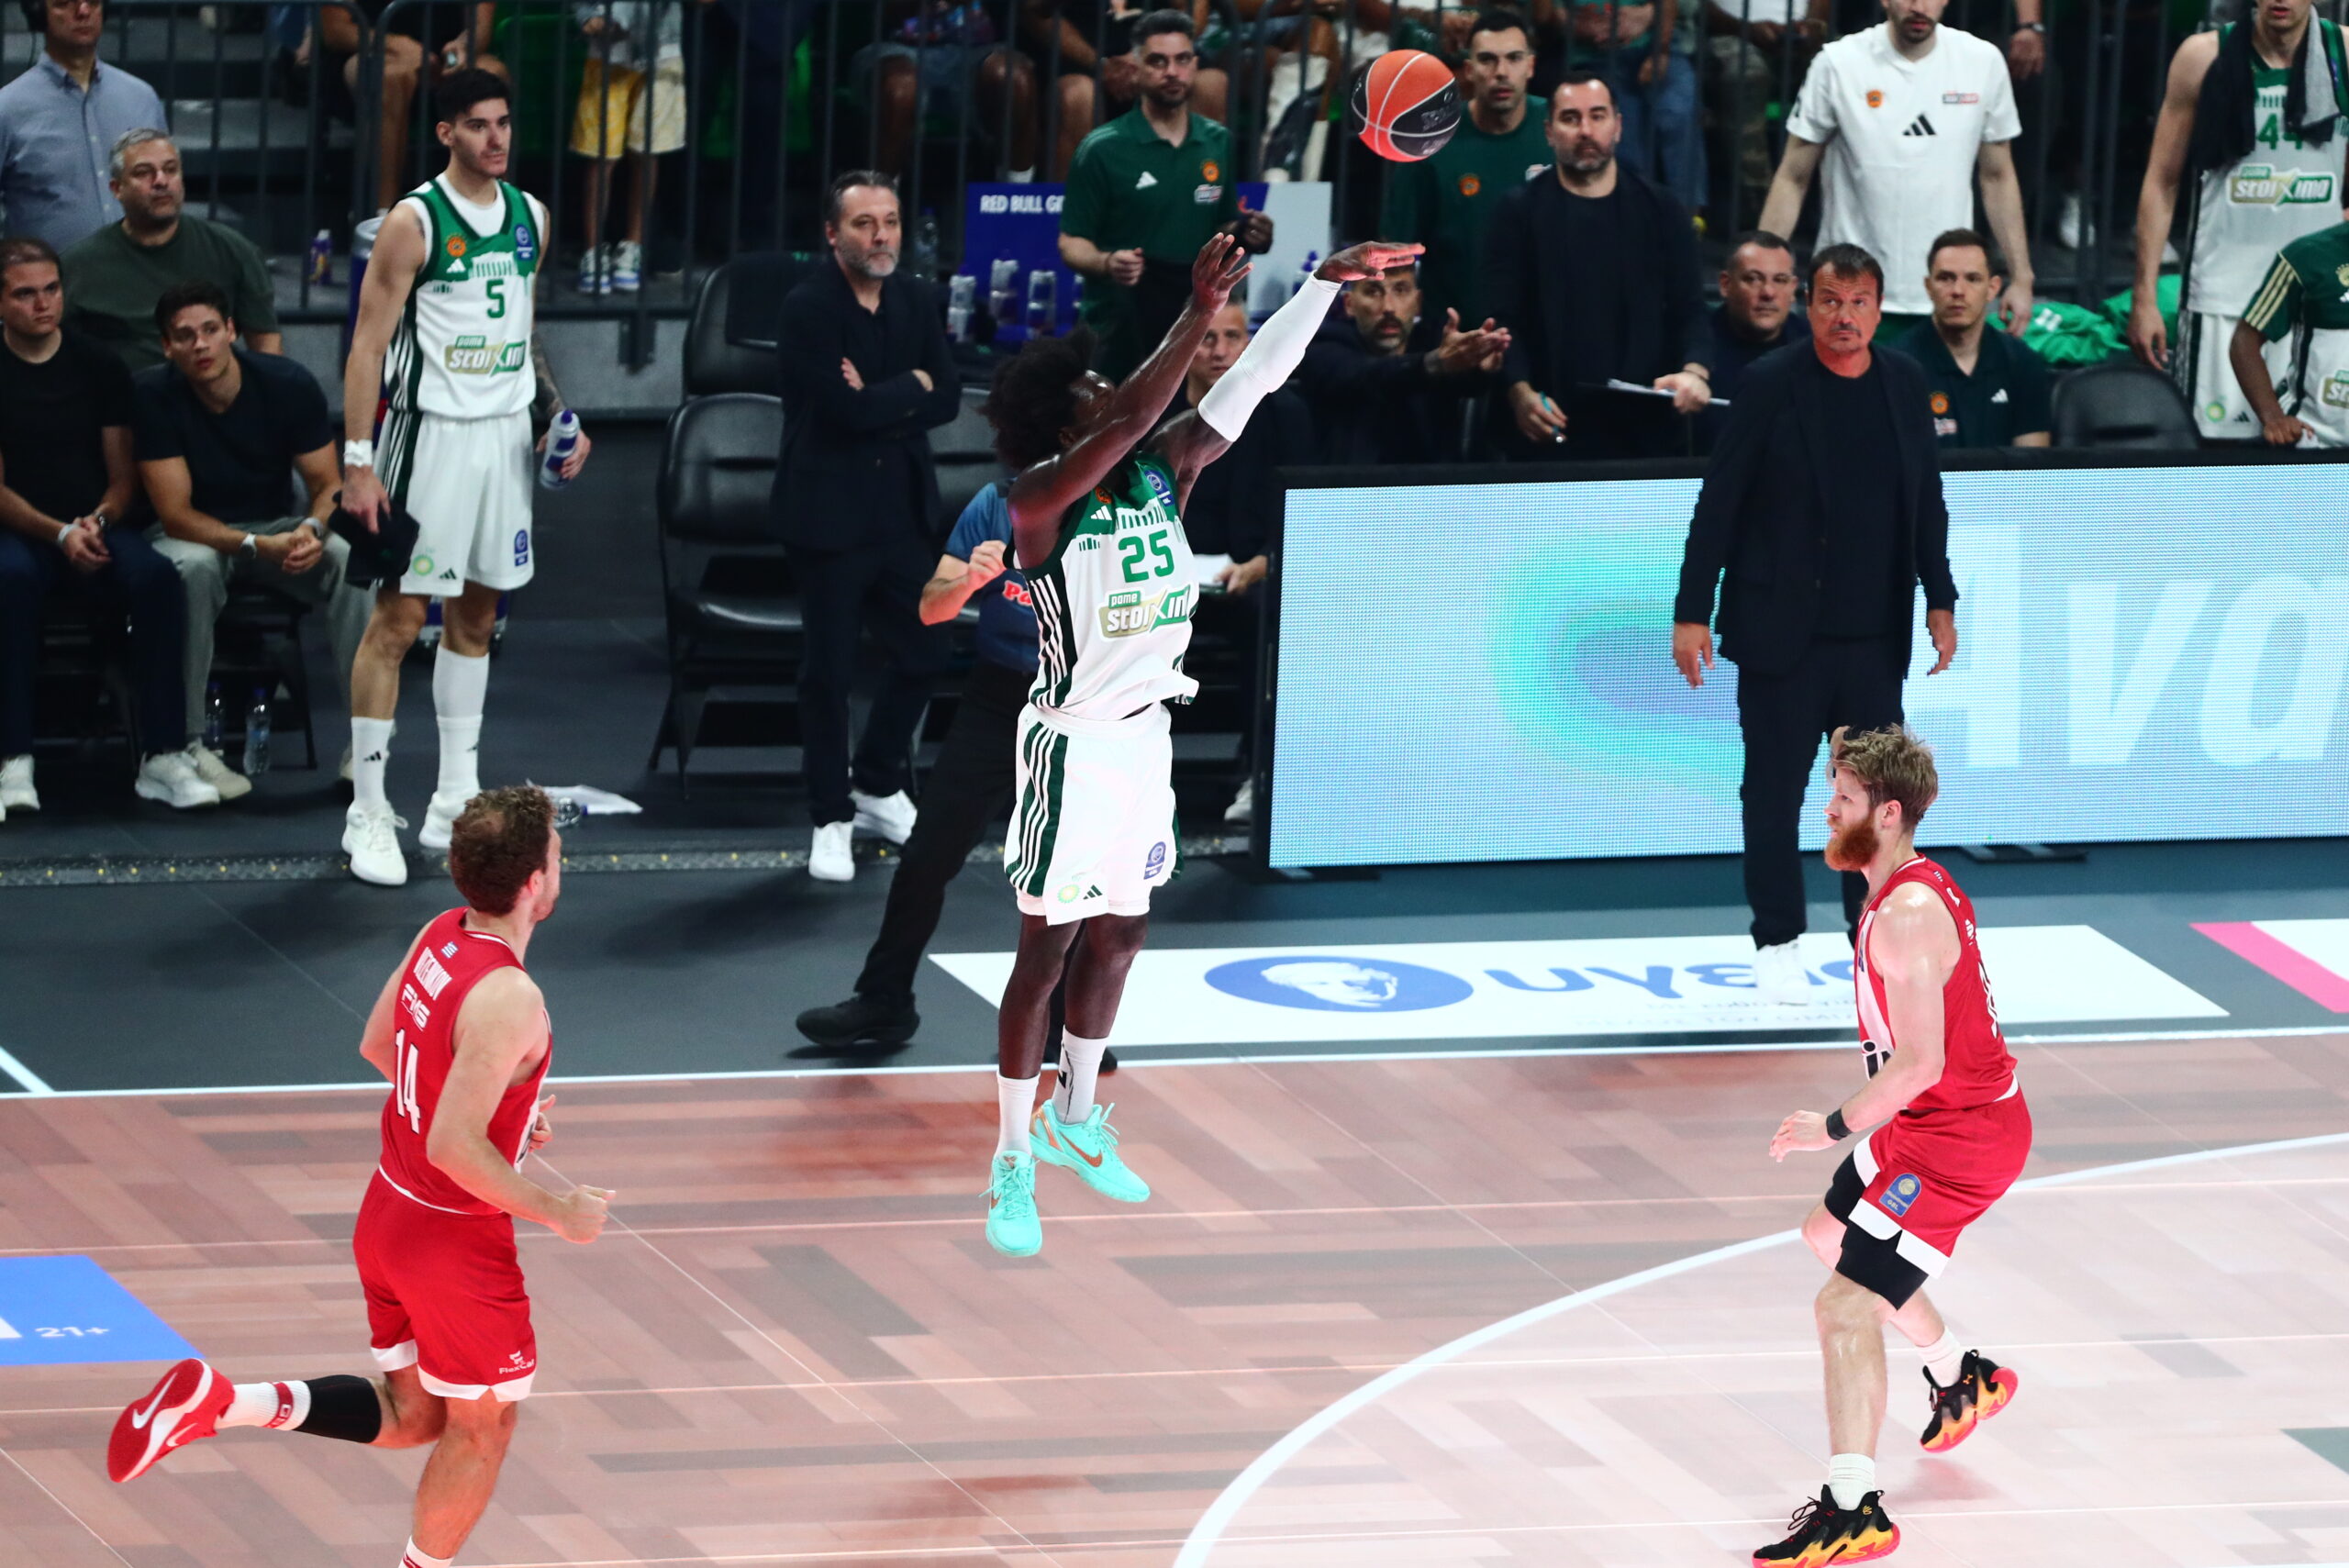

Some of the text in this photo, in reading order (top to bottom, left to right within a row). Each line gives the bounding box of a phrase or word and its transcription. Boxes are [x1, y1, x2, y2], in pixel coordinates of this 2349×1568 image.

[980, 195, 1064, 213] RED BULL GI
[486, 279, 505, 318] 5
[1118, 529, 1175, 583] 25
[1003, 580, 1032, 606] Pa
[1111, 593, 1138, 606] pame
[395, 1029, 421, 1134] 14
[35, 1326, 109, 1338] 21+
